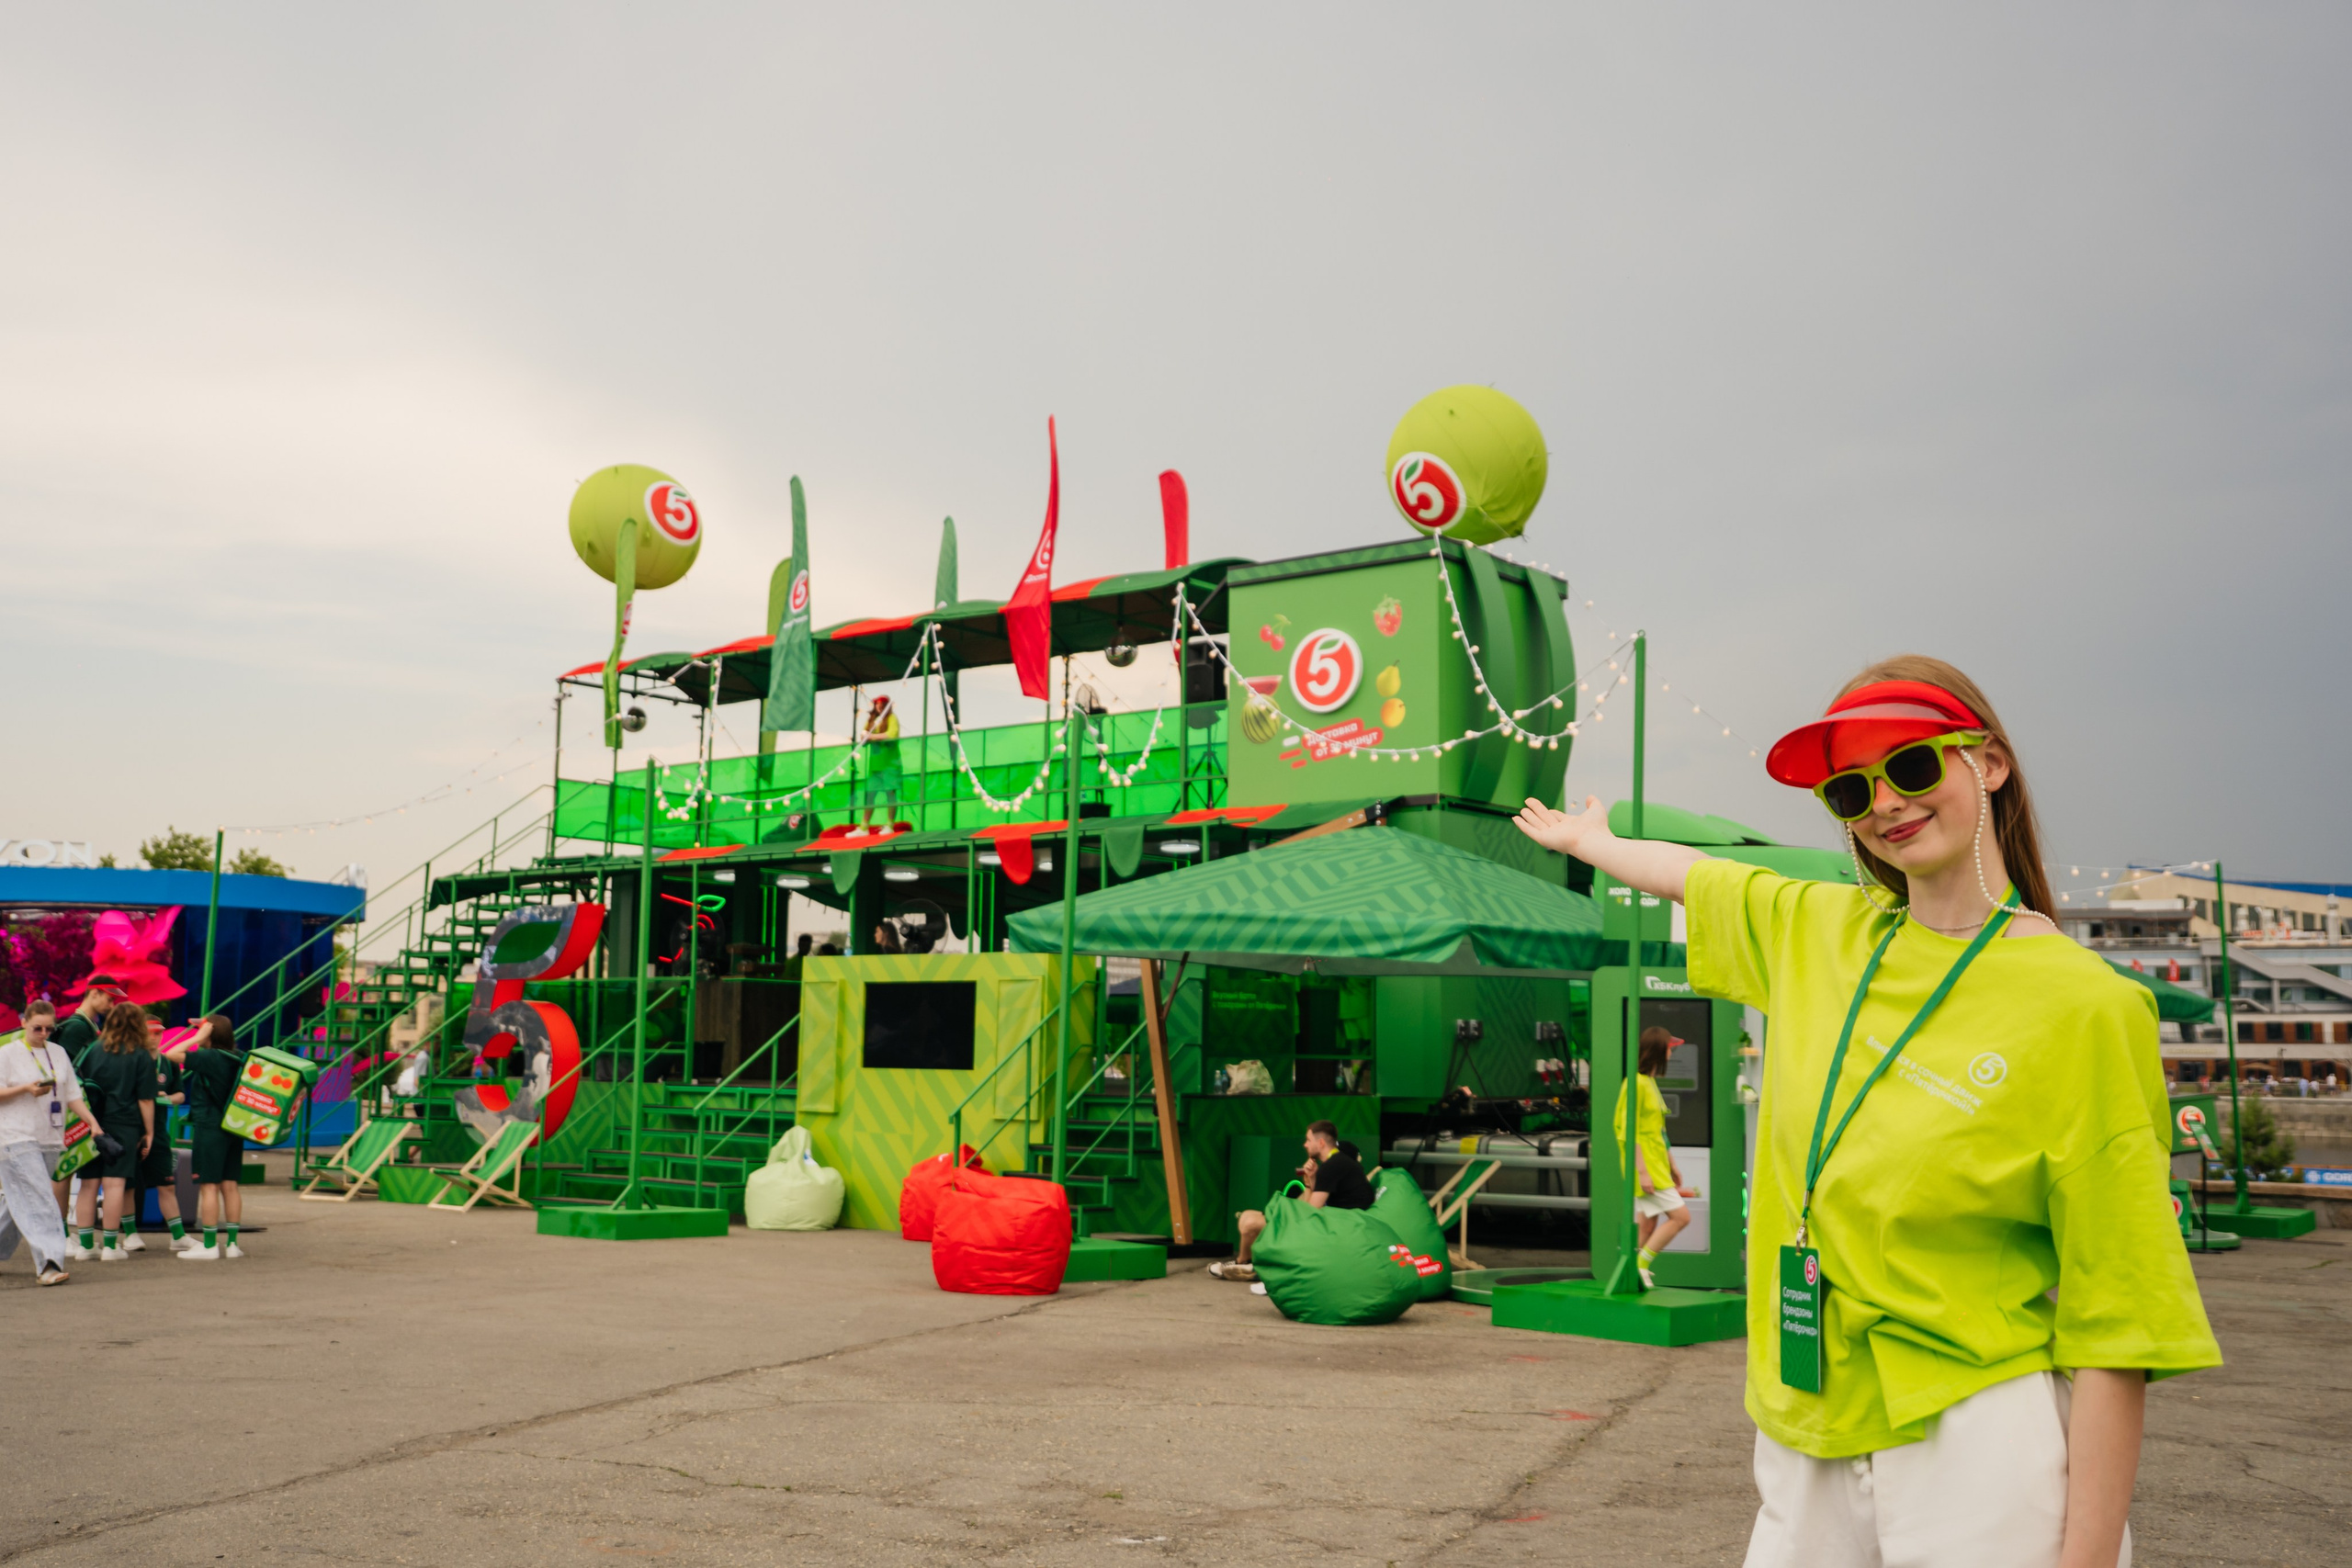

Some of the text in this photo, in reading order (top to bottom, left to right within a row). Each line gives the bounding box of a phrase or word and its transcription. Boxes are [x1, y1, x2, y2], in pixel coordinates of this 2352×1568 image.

[1399, 457, 1445, 521] 5
[1306, 633, 1345, 698] 5
[0, 839, 94, 868] ON
[1782, 1286, 1812, 1302] Сотрудник
[1782, 1303, 1814, 1319] брендзоны
